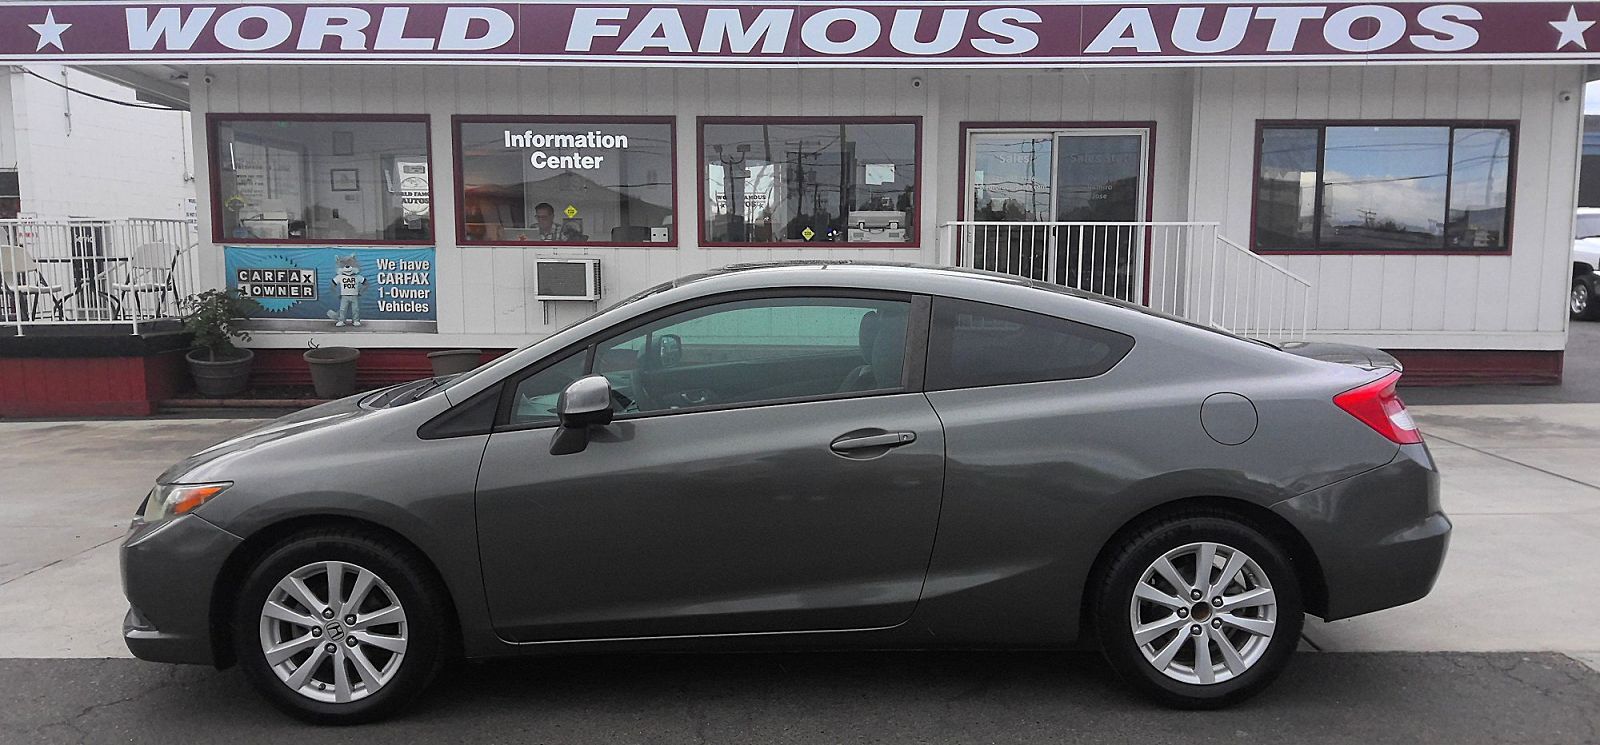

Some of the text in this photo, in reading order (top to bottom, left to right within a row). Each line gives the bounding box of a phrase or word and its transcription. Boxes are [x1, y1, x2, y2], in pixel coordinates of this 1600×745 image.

[125, 4, 1482, 55] WORLD FAMOUS AUTOS
[504, 130, 628, 149] Information
[530, 151, 604, 169] Center
[999, 153, 1030, 164] Sales
[377, 259, 430, 270] We have
[239, 271, 314, 284] CARFAX
[377, 273, 430, 285] CARFAX
[253, 286, 314, 297] OWNER
[378, 287, 430, 299] 1-Owner
[377, 300, 430, 313] Vehicles
